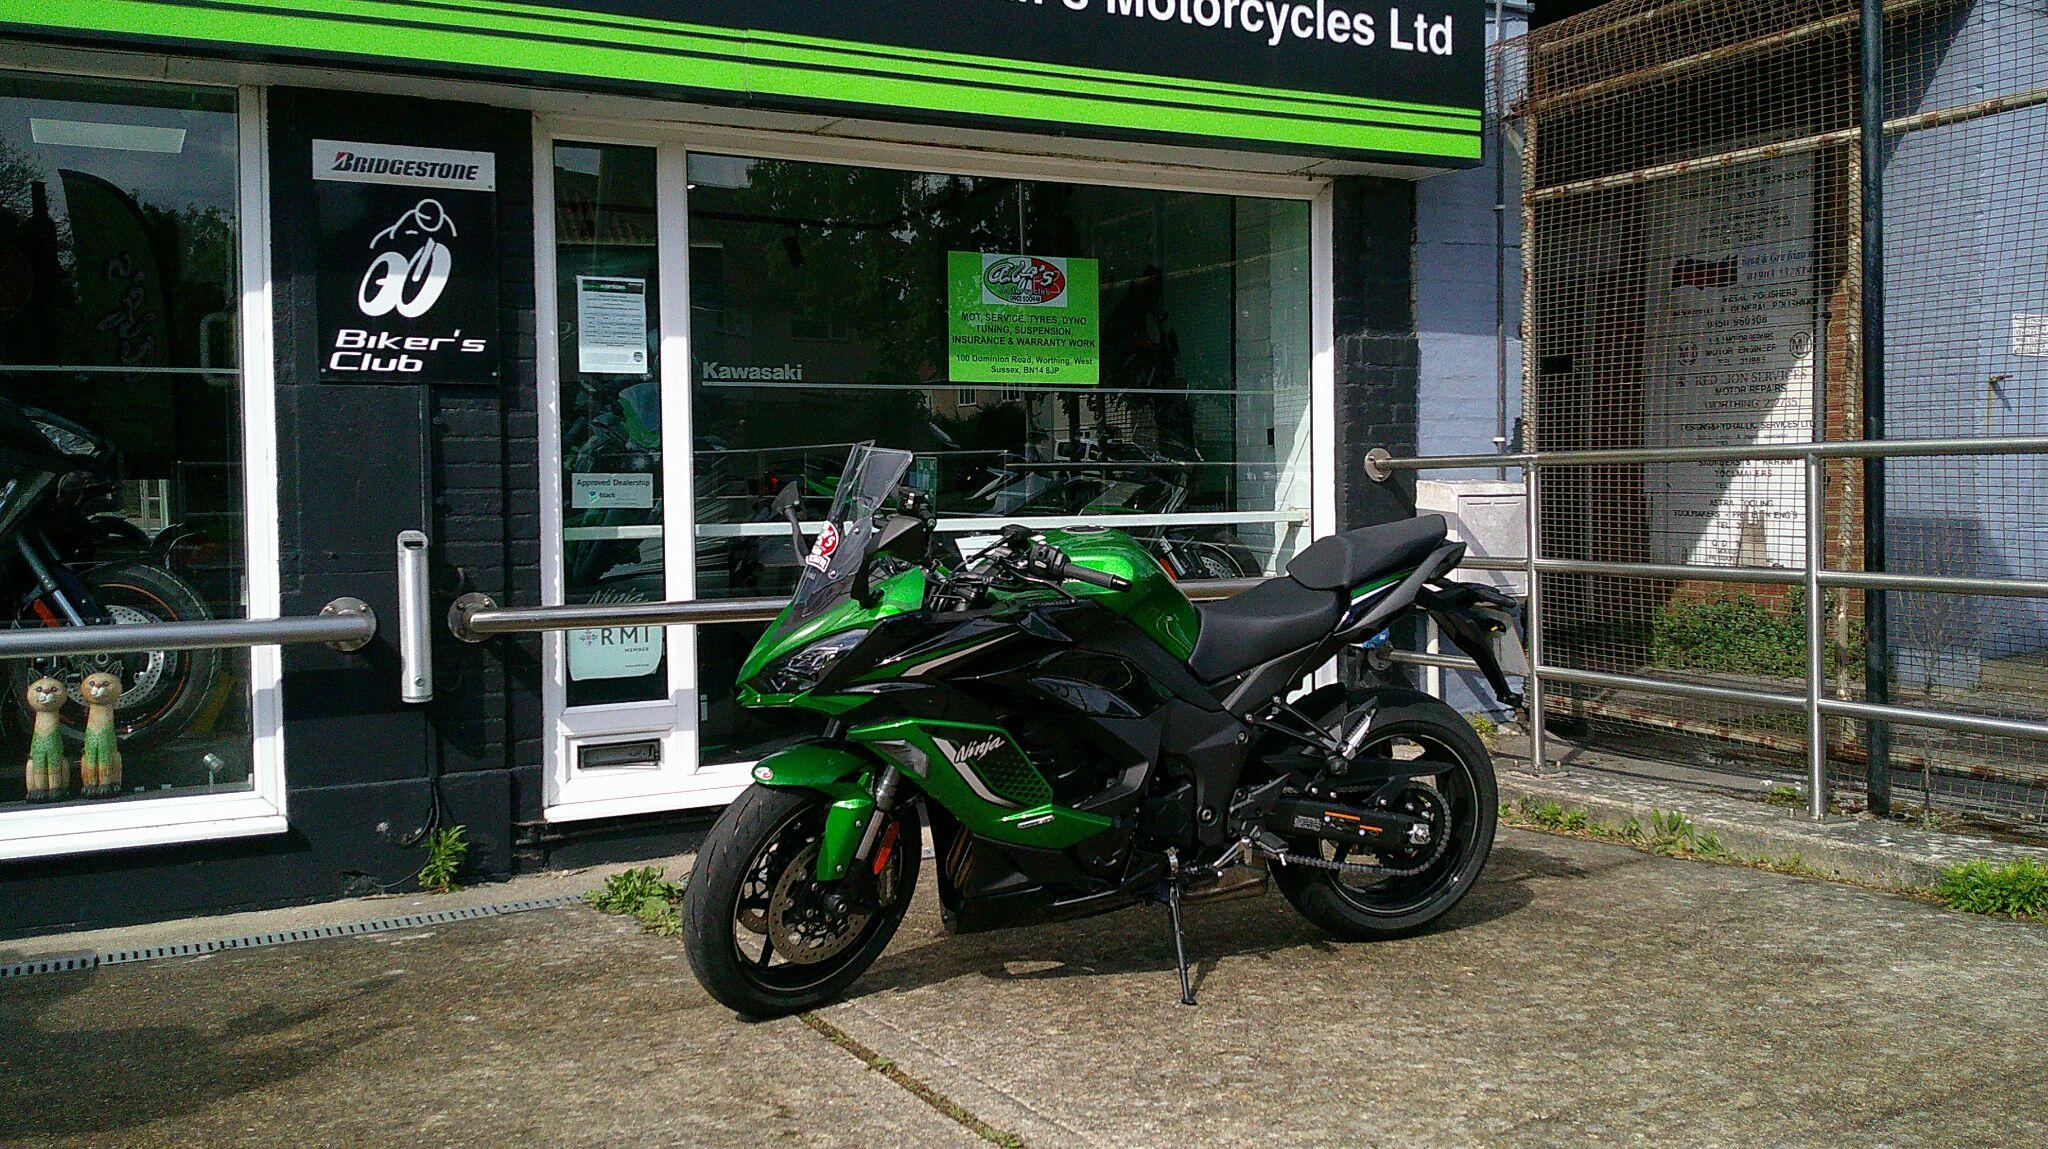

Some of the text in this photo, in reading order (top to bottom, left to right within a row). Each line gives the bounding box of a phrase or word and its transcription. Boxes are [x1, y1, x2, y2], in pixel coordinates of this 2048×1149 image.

[1391, 7, 1453, 56] Ltd
[331, 151, 480, 181] BRIDGESTONE
[1062, 316, 1088, 326] DYNO
[975, 325, 1074, 337] TUNING, SUSPENSION,
[335, 328, 487, 353] Biker's
[952, 336, 1096, 348] INSURANCE & WARRANTY WORK
[329, 351, 424, 372] Club
[956, 354, 970, 363] 100
[972, 355, 1010, 364] Dominion
[1074, 358, 1093, 366] West
[702, 361, 803, 381] Kawasaki
[1024, 366, 1044, 375] BN14
[1046, 367, 1060, 375] 8JP
[1751, 368, 1808, 383] SERVICES
[1715, 386, 1747, 396] MOTOR
[1760, 420, 1799, 430] SERVICES
[576, 479, 651, 488] Approved Dealership
[601, 626, 649, 646] RMI
[624, 646, 650, 654] MEMBER
[954, 733, 1006, 762] Ninja
